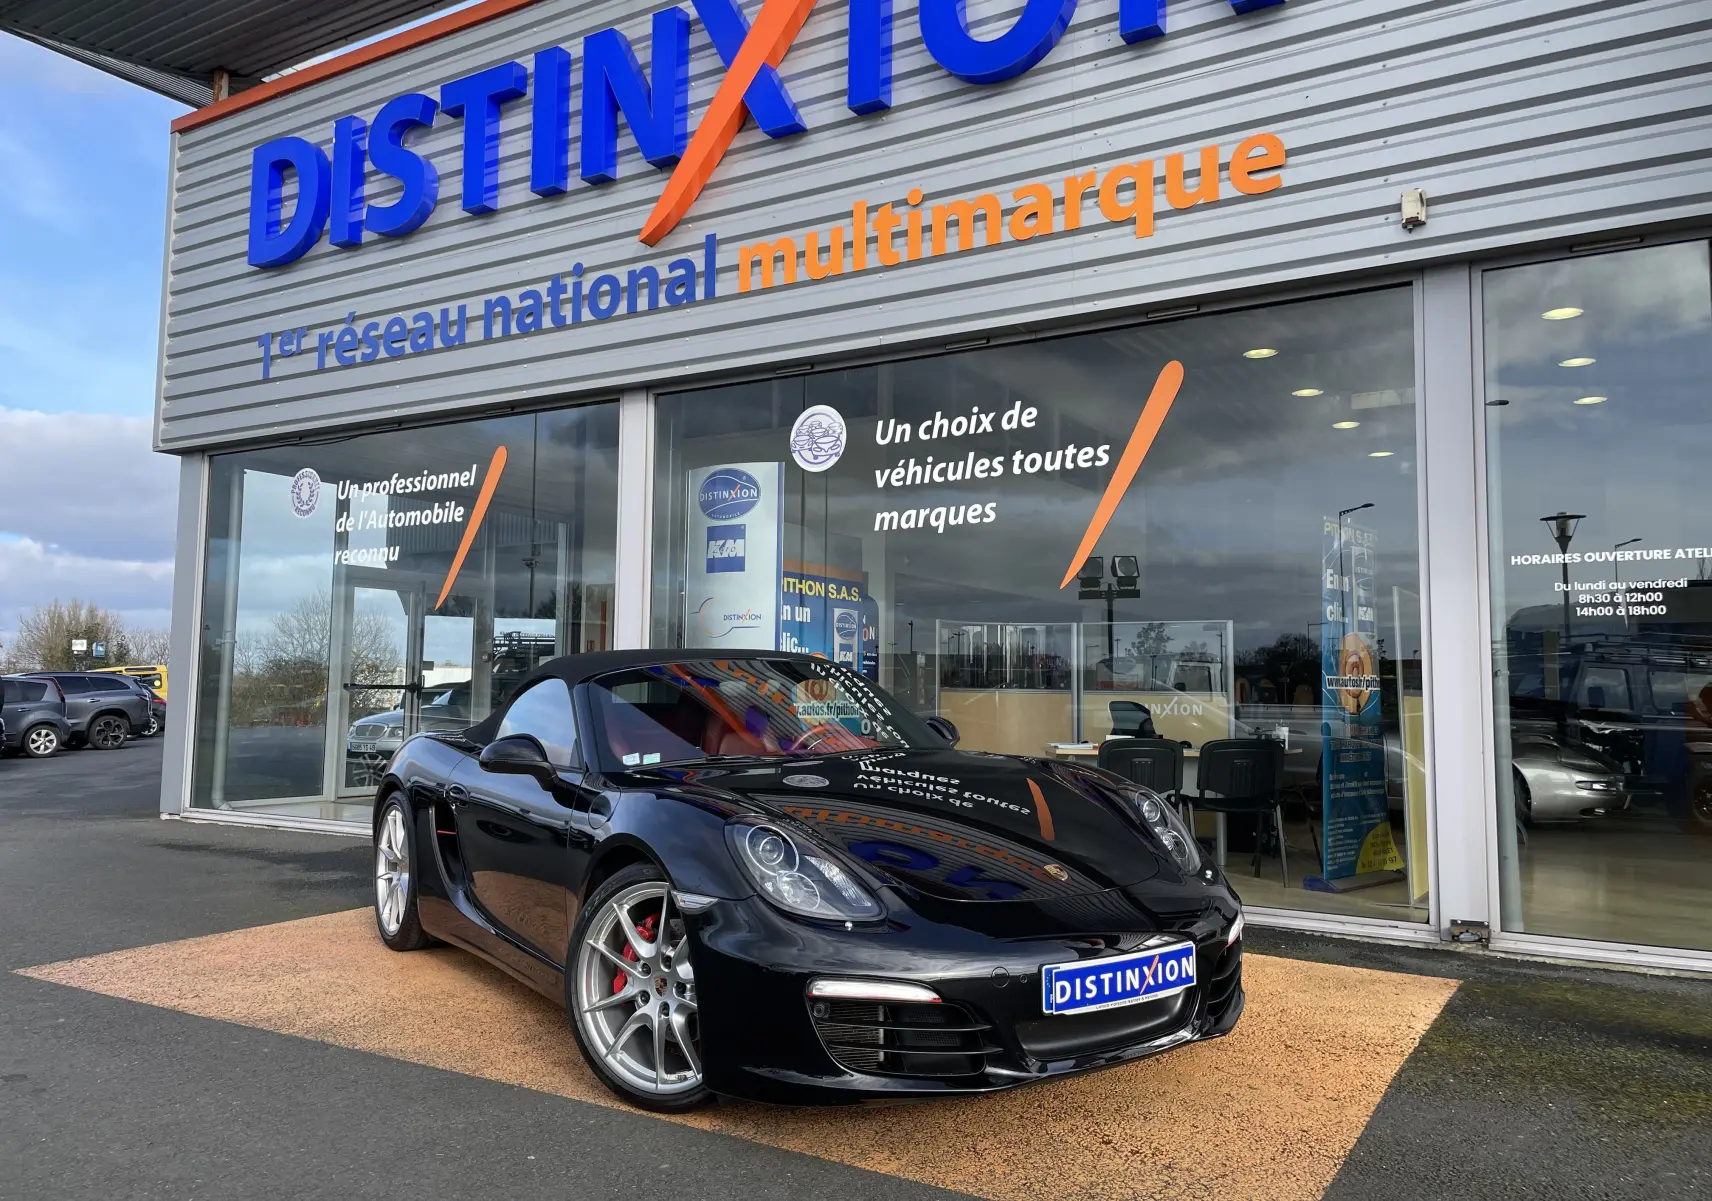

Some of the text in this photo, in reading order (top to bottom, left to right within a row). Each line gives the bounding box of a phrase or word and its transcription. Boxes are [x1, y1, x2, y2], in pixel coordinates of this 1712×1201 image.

[257, 133, 1287, 379] 1er réseau national multimarque
[875, 400, 1038, 445] Un choix de
[874, 443, 1111, 488] véhicules toutes
[337, 464, 477, 502] Un professionnel
[700, 484, 758, 502] DISTINXION
[336, 501, 465, 532] de l'Automobile
[874, 502, 997, 533] marques
[334, 546, 400, 565] reconnu
[1511, 553, 1581, 565] HORAIRES
[1584, 549, 1672, 563] OUVERTURE
[781, 577, 862, 601] ITHON S.A.S.
[1554, 578, 1688, 591] Du lundi au vendredi
[1579, 592, 1663, 603] 8h30 à 12h00
[724, 608, 762, 623] DISTINXION
[795, 606, 811, 622] un
[1576, 605, 1667, 616] 14h00 à 18h00
[1055, 954, 1193, 1004] DISTINXION
